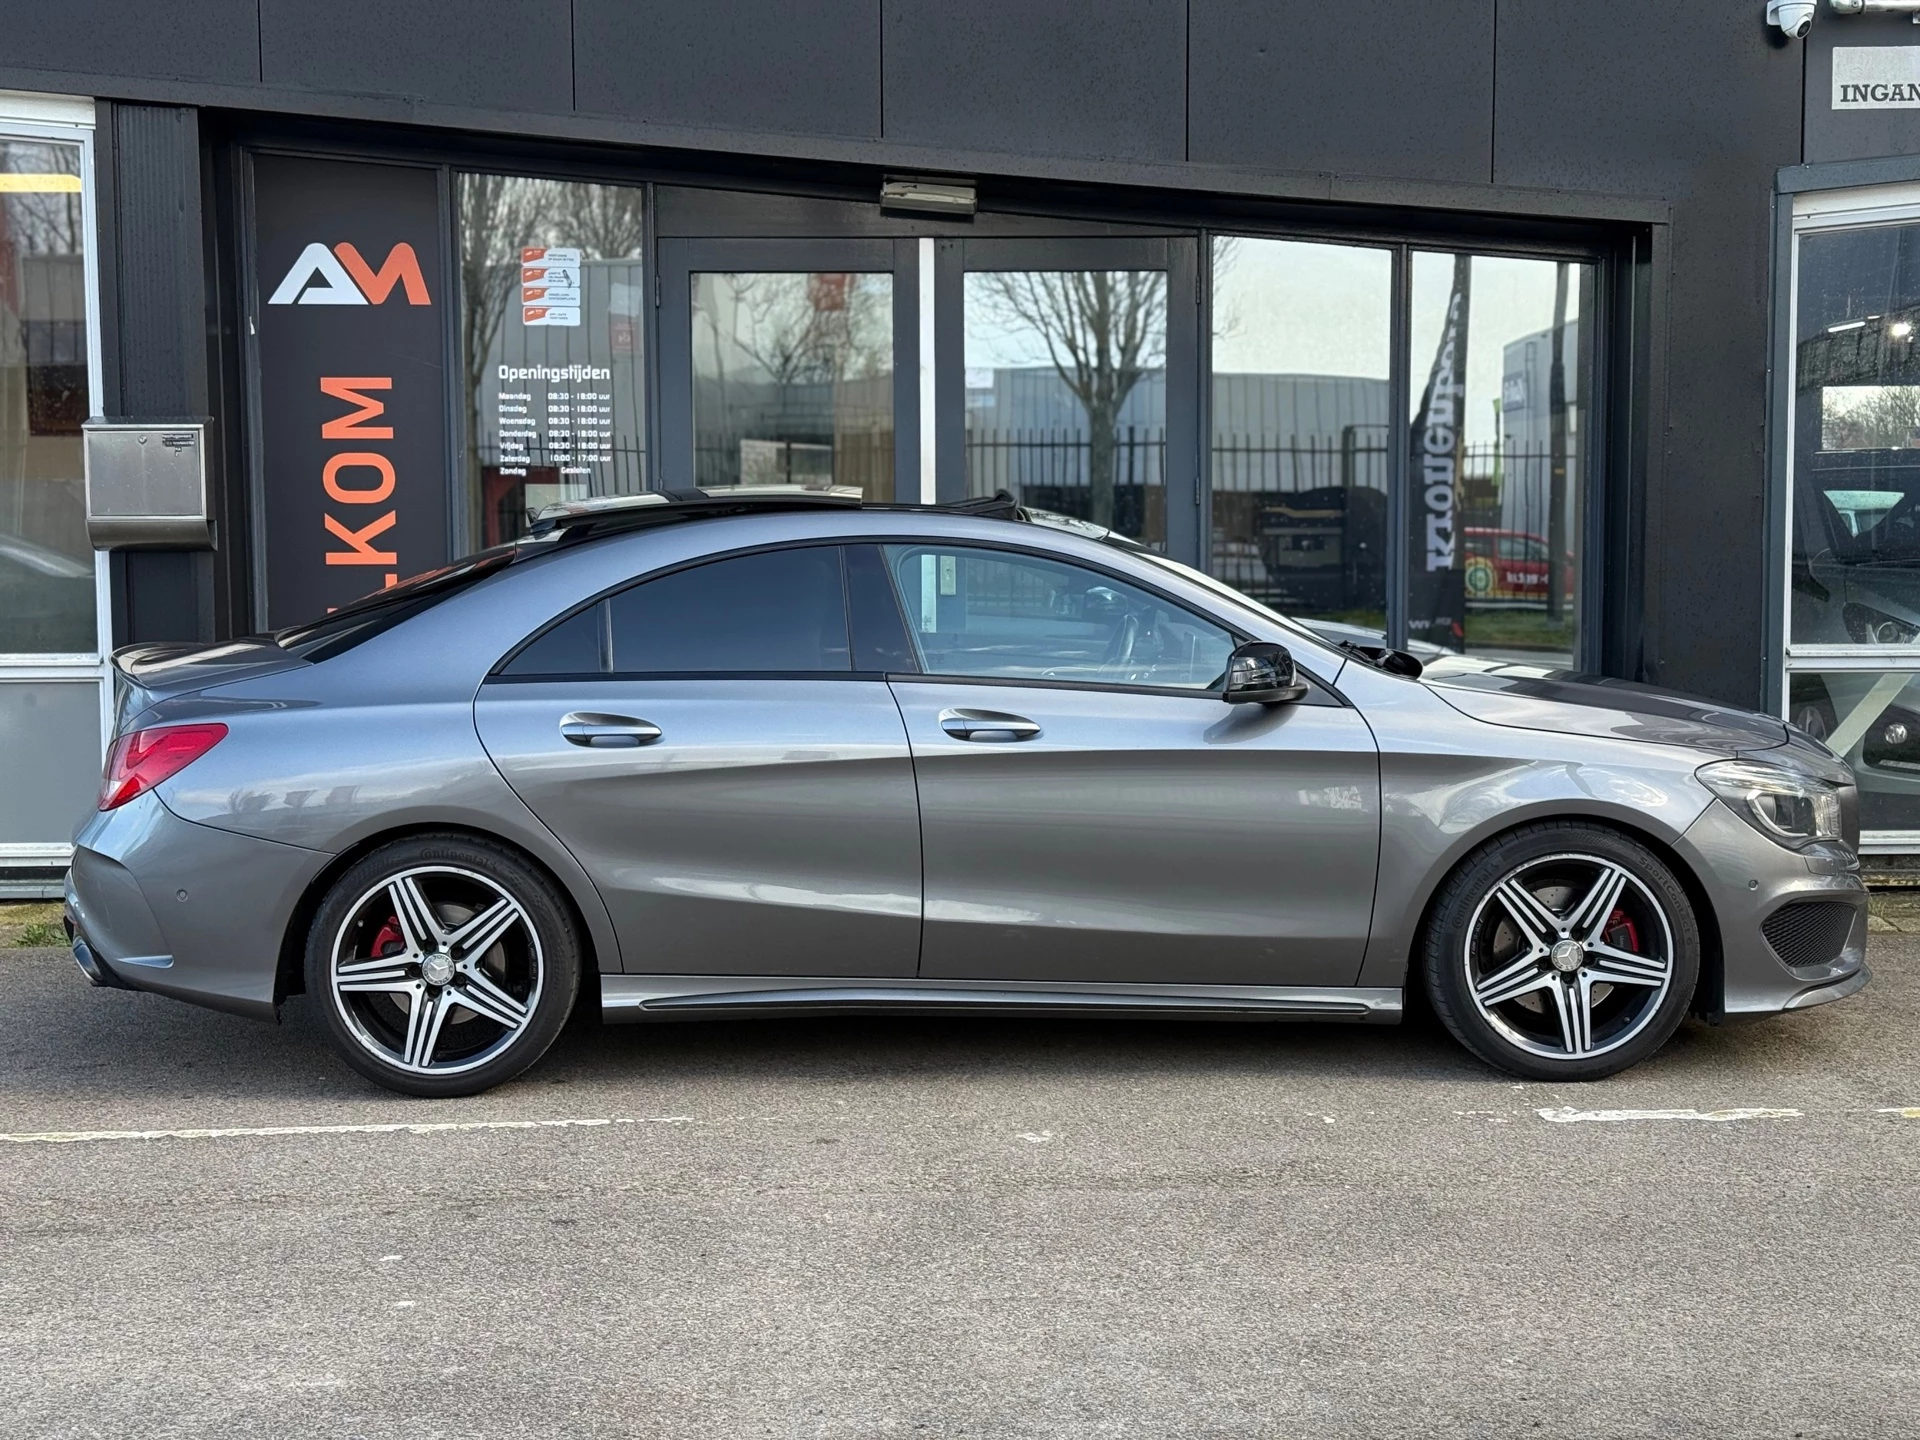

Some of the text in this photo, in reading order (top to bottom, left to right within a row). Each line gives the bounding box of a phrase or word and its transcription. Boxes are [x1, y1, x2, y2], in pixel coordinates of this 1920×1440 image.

[267, 241, 432, 306] AM
[498, 363, 611, 383] Openingstijden
[498, 392, 532, 402] Maandag
[498, 405, 528, 413] Dinsdag
[499, 418, 536, 426] Woensdag
[499, 430, 537, 438] Donderdag
[500, 442, 524, 450] Vrijdag
[578, 442, 598, 450] 18:00
[500, 455, 530, 463] Zaterdag
[500, 467, 527, 475] Zondag
